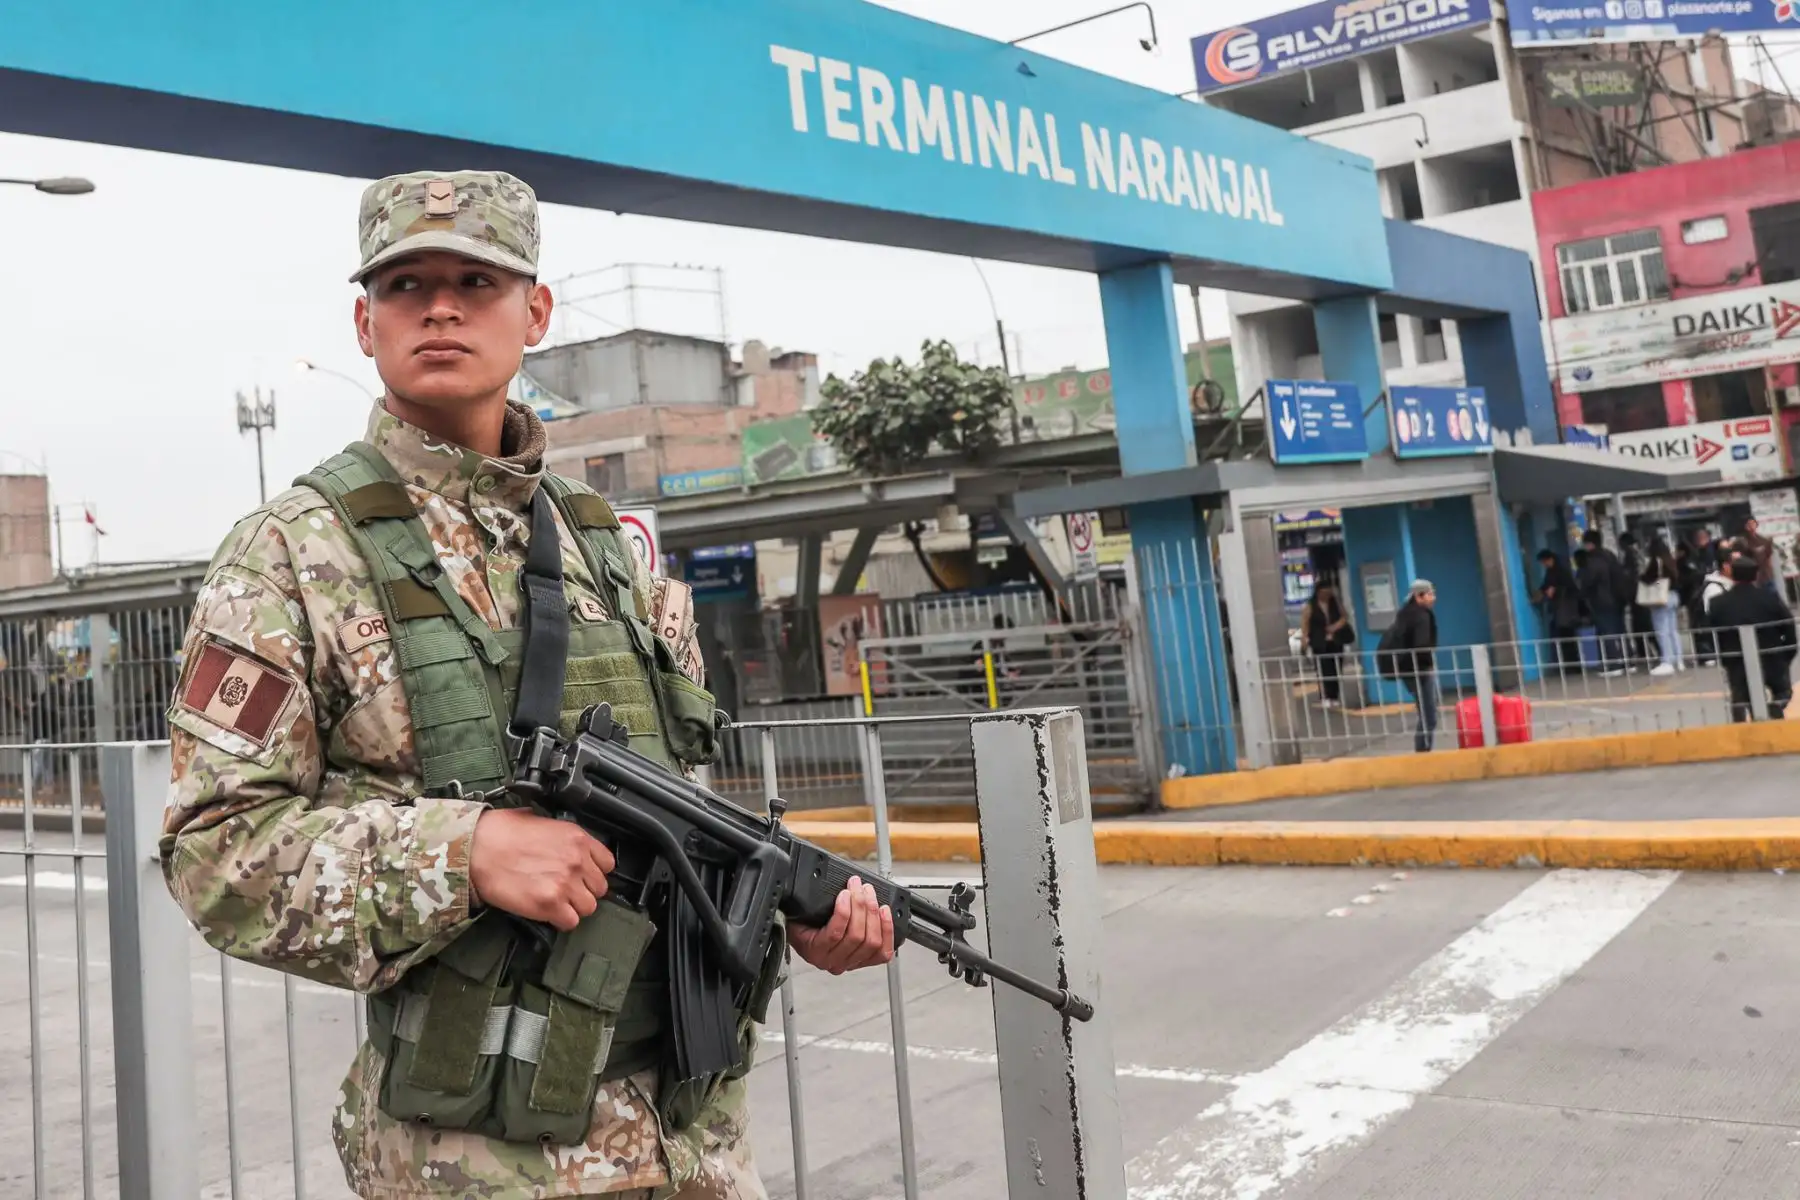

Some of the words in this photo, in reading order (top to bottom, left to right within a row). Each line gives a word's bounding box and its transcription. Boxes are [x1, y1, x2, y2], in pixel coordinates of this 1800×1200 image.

[770, 44, 1077, 186] TERMINAL
[1080, 122, 1285, 226] NARANJAL
[1672, 303, 1766, 337] DAIKI
